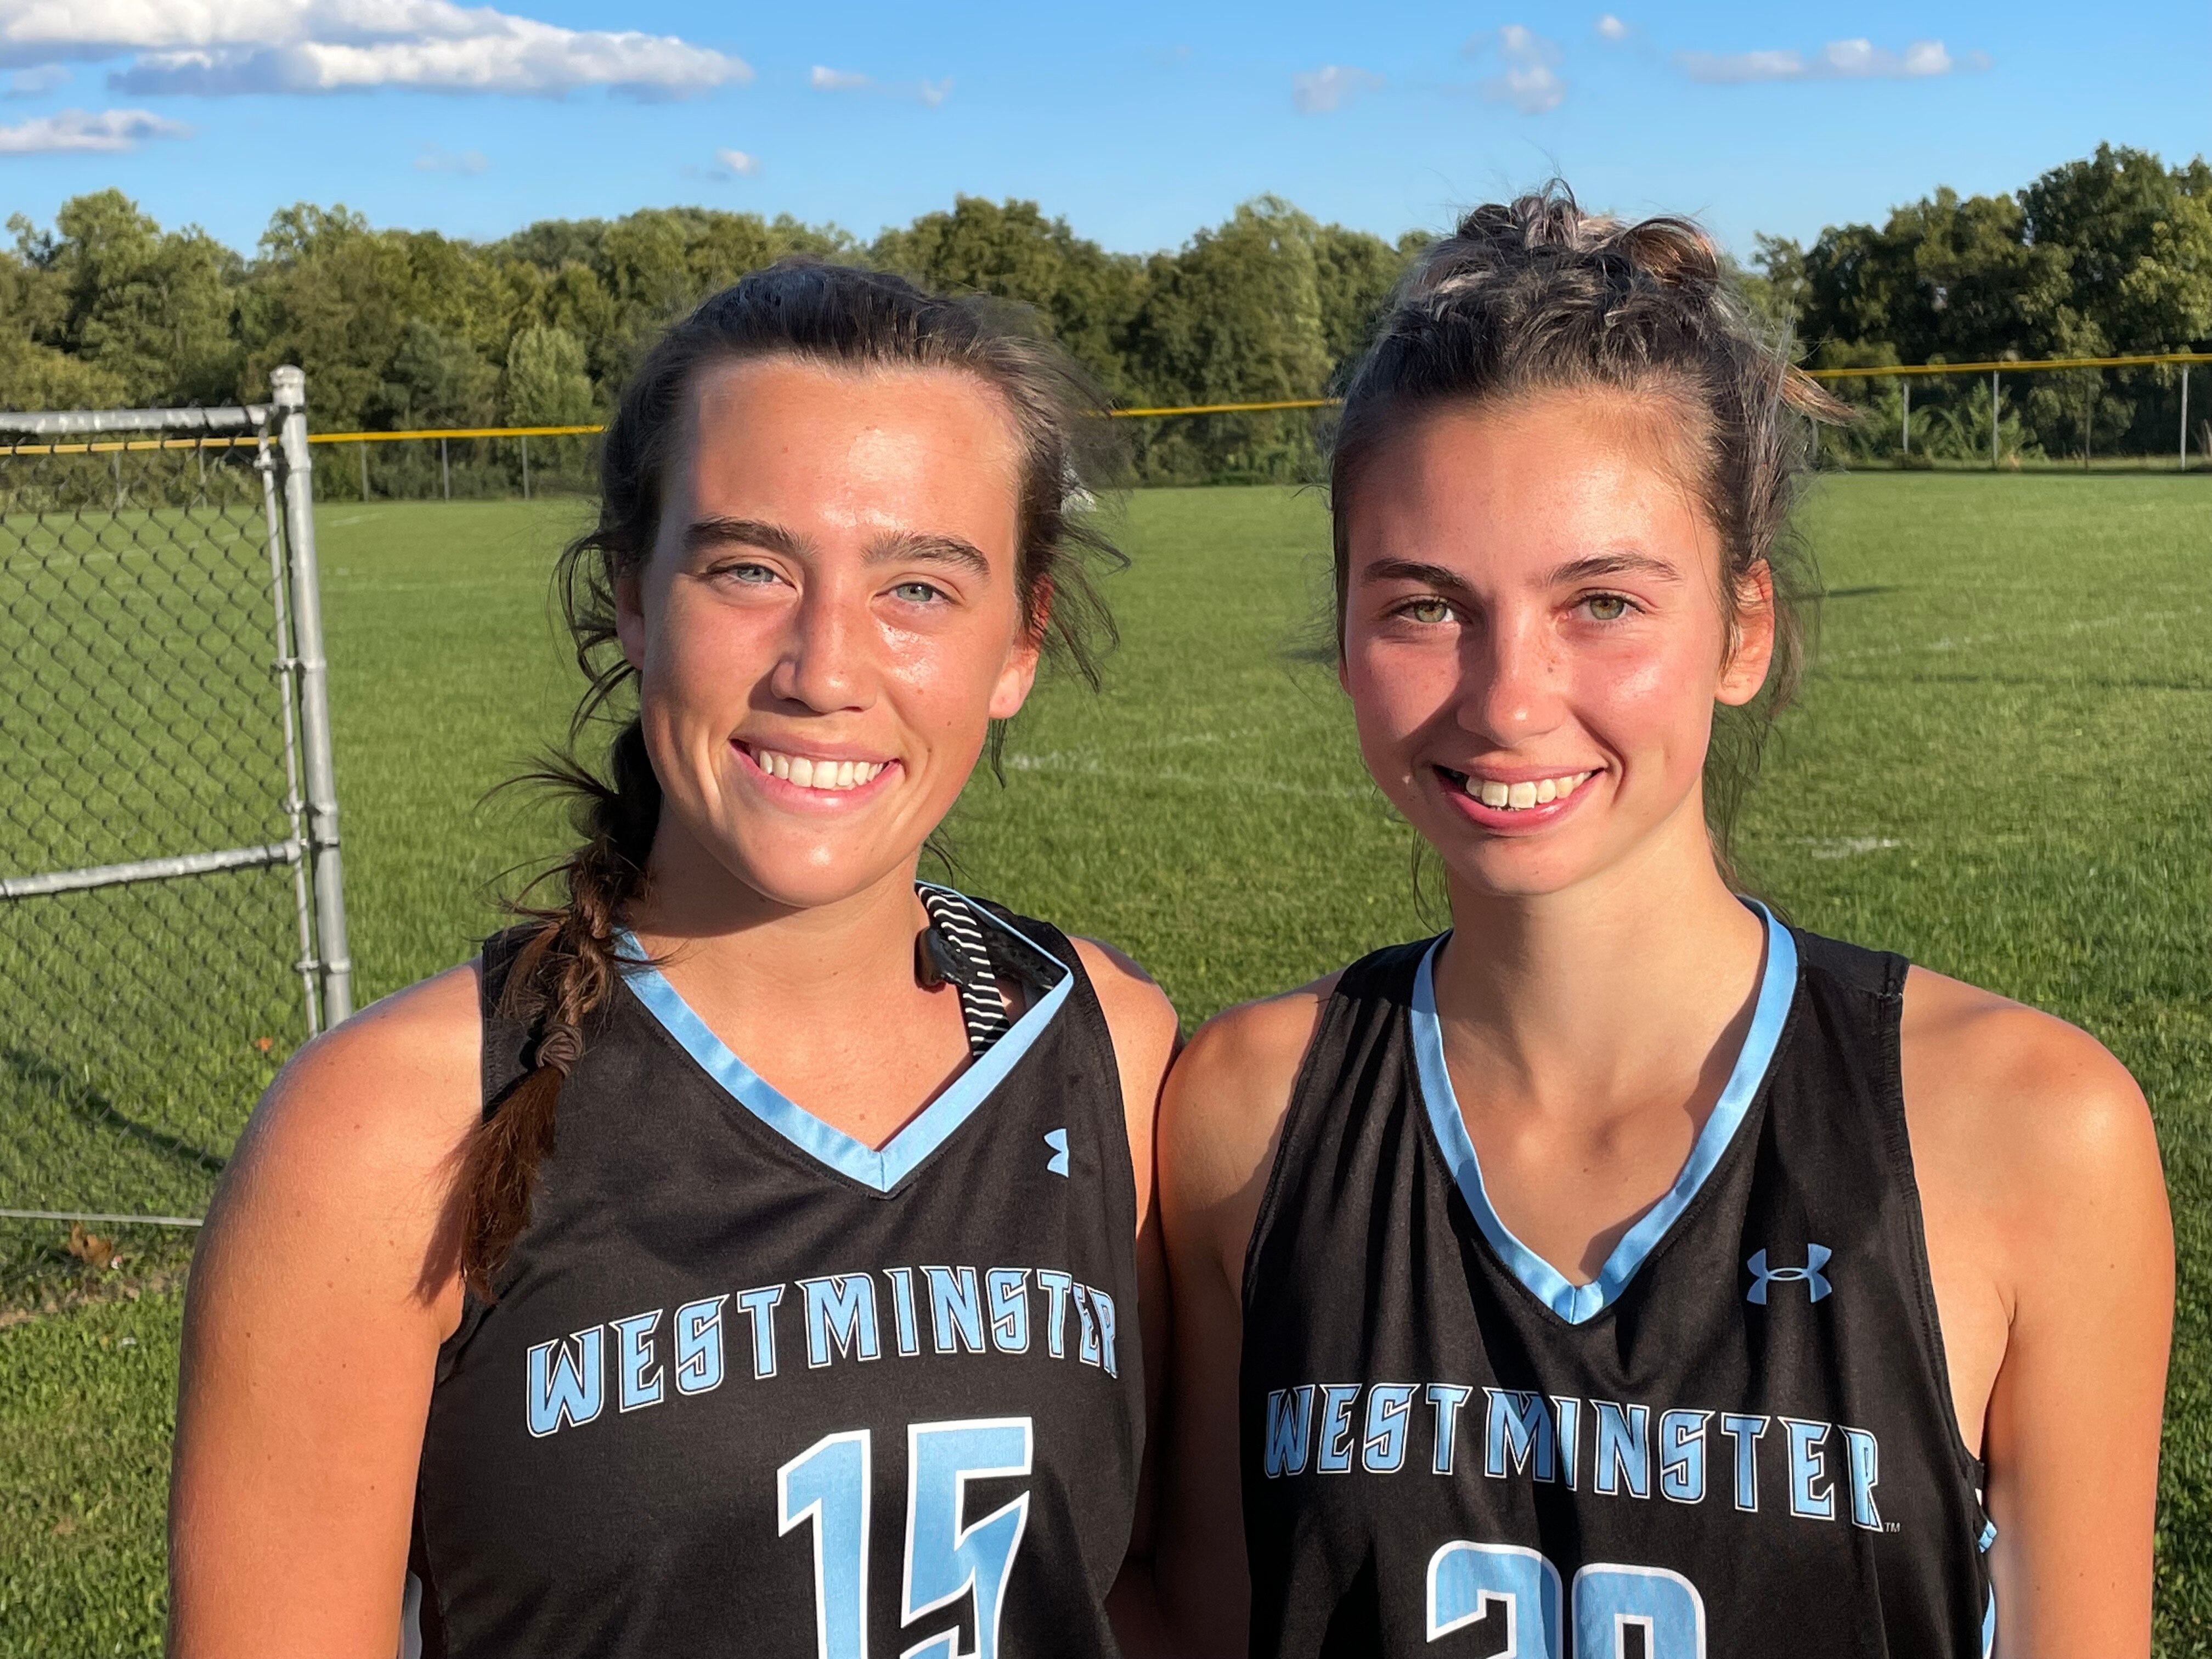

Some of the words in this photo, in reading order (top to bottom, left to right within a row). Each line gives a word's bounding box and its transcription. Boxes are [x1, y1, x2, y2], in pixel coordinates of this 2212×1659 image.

[526, 1265, 1120, 1437] WESTMINSTER
[777, 1417, 1033, 1659] 15
[1264, 1382, 1884, 1533] WESTMINSTER
[1884, 1522, 1901, 1533] TM
